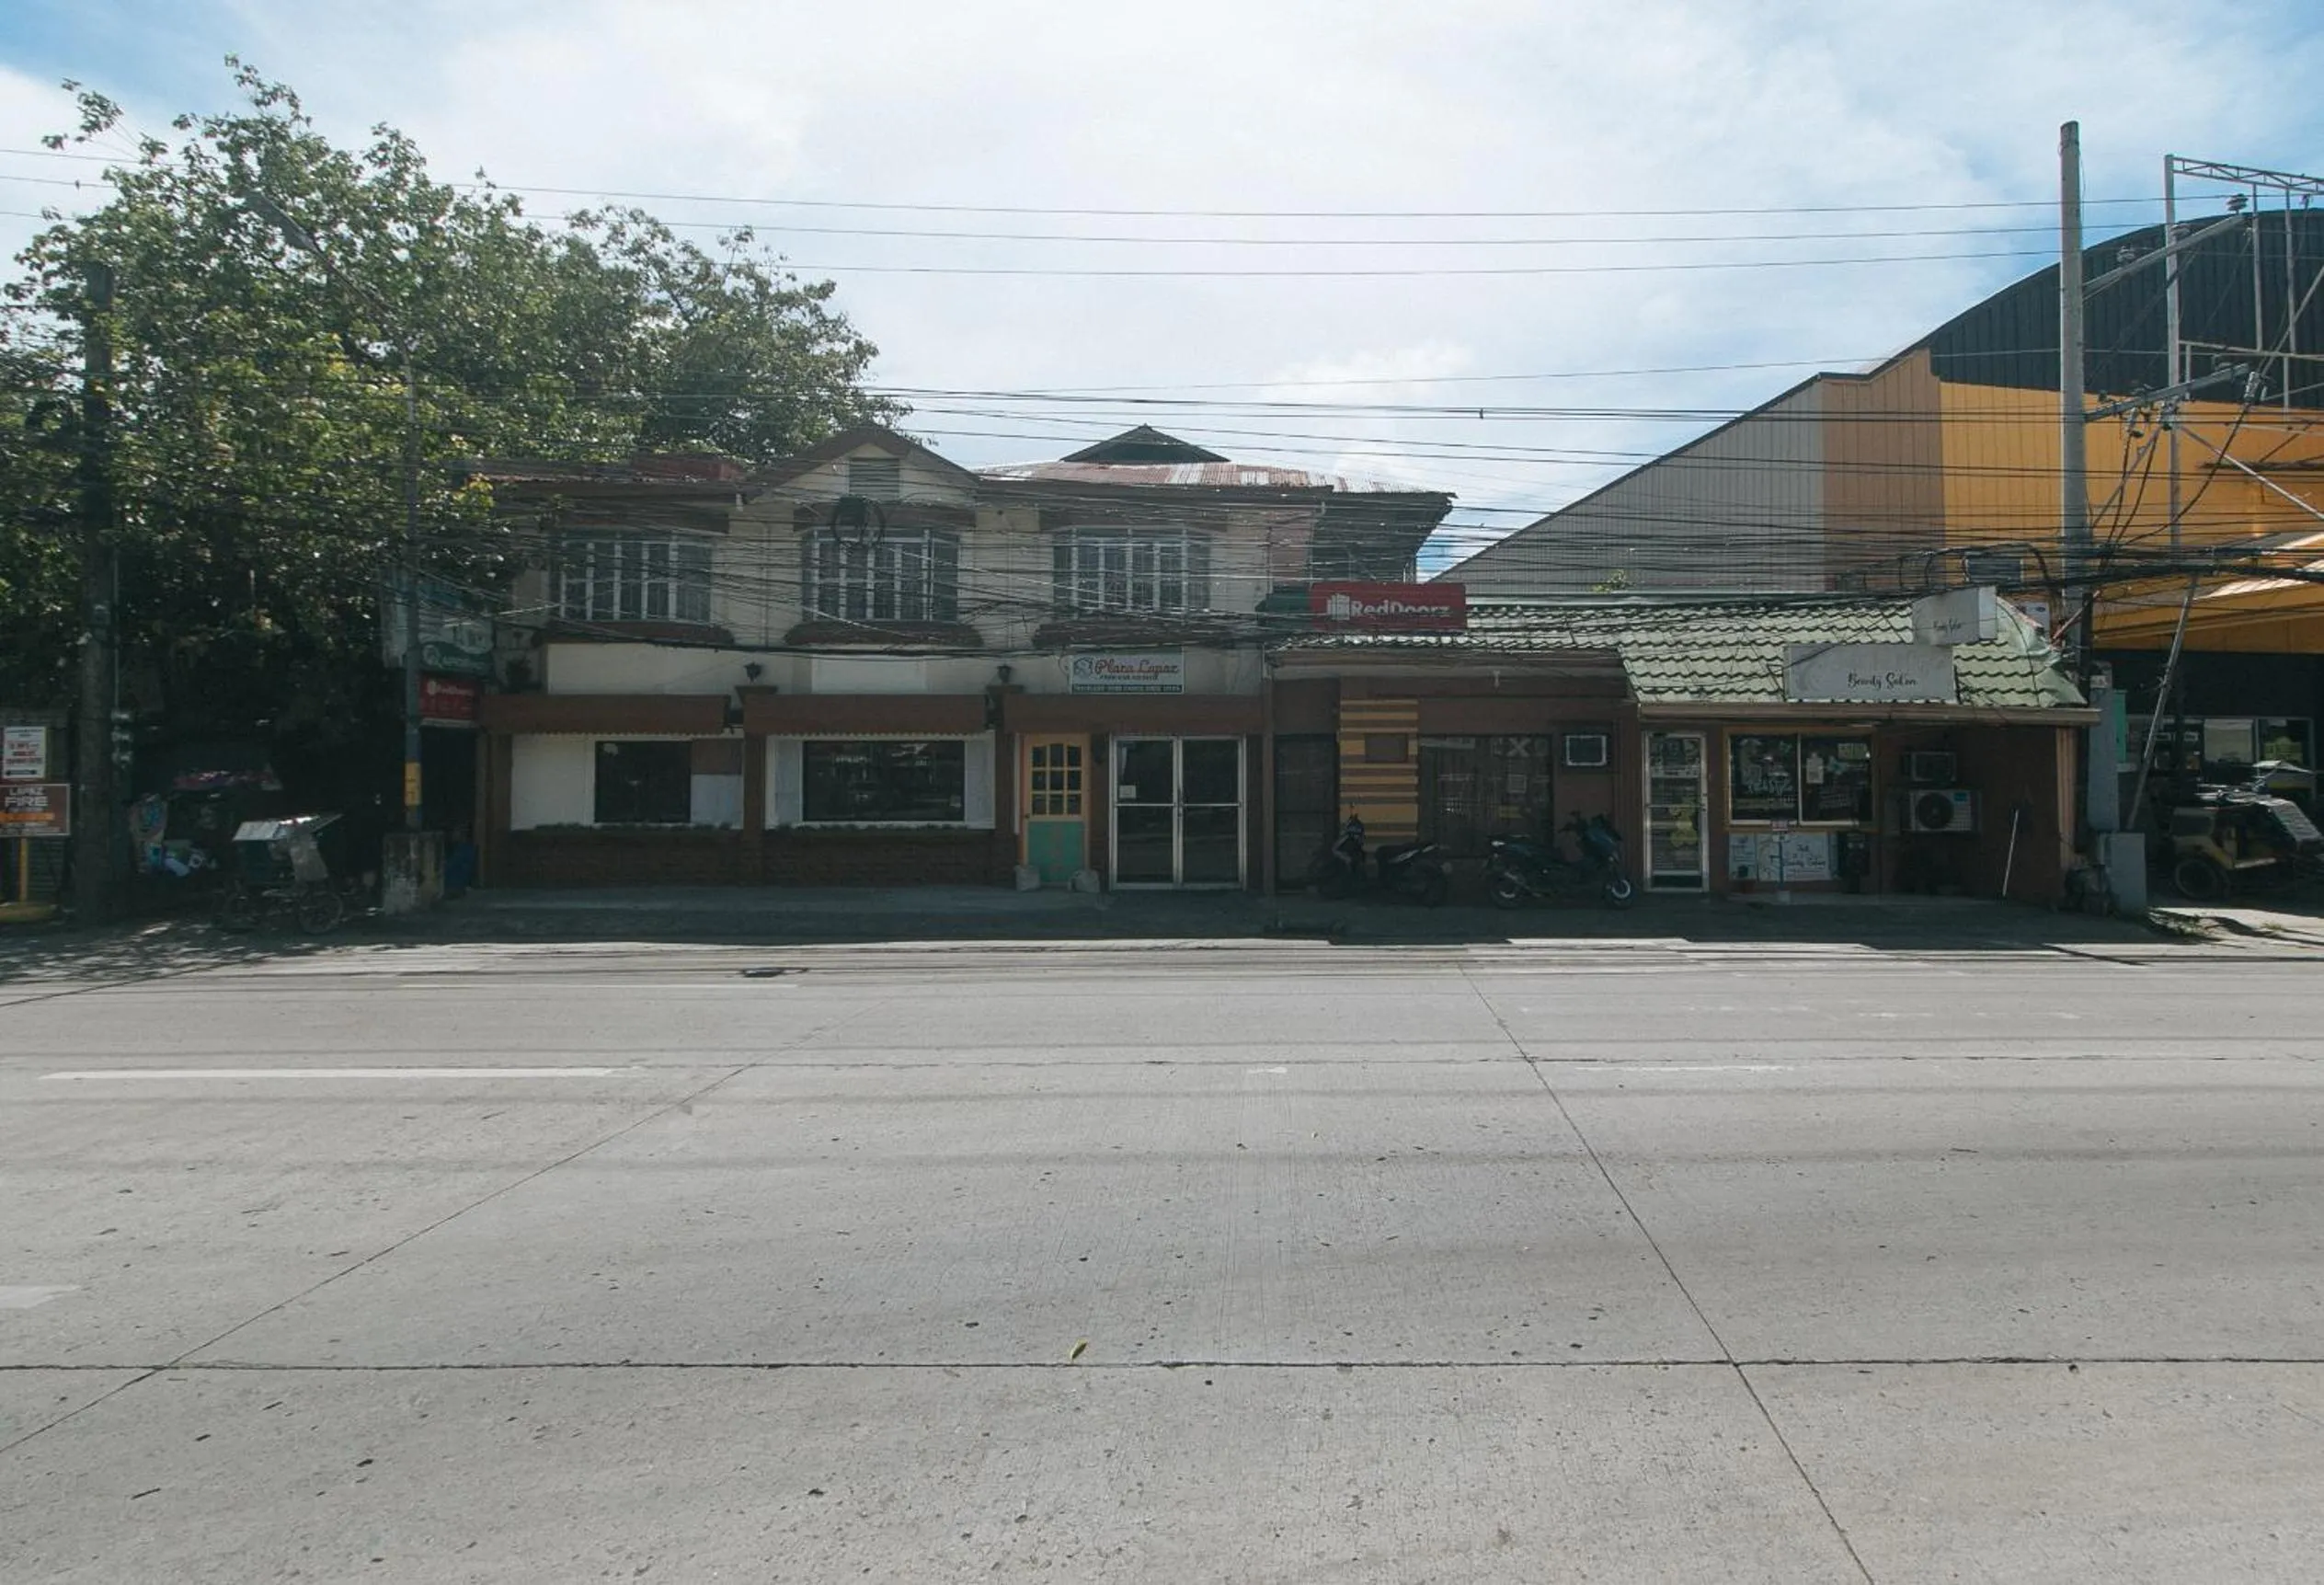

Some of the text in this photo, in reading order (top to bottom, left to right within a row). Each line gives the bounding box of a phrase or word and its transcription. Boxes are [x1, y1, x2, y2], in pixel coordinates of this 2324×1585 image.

[1350, 599, 1450, 617] RedDoorz
[1847, 671, 1916, 689] Beauty Salon
